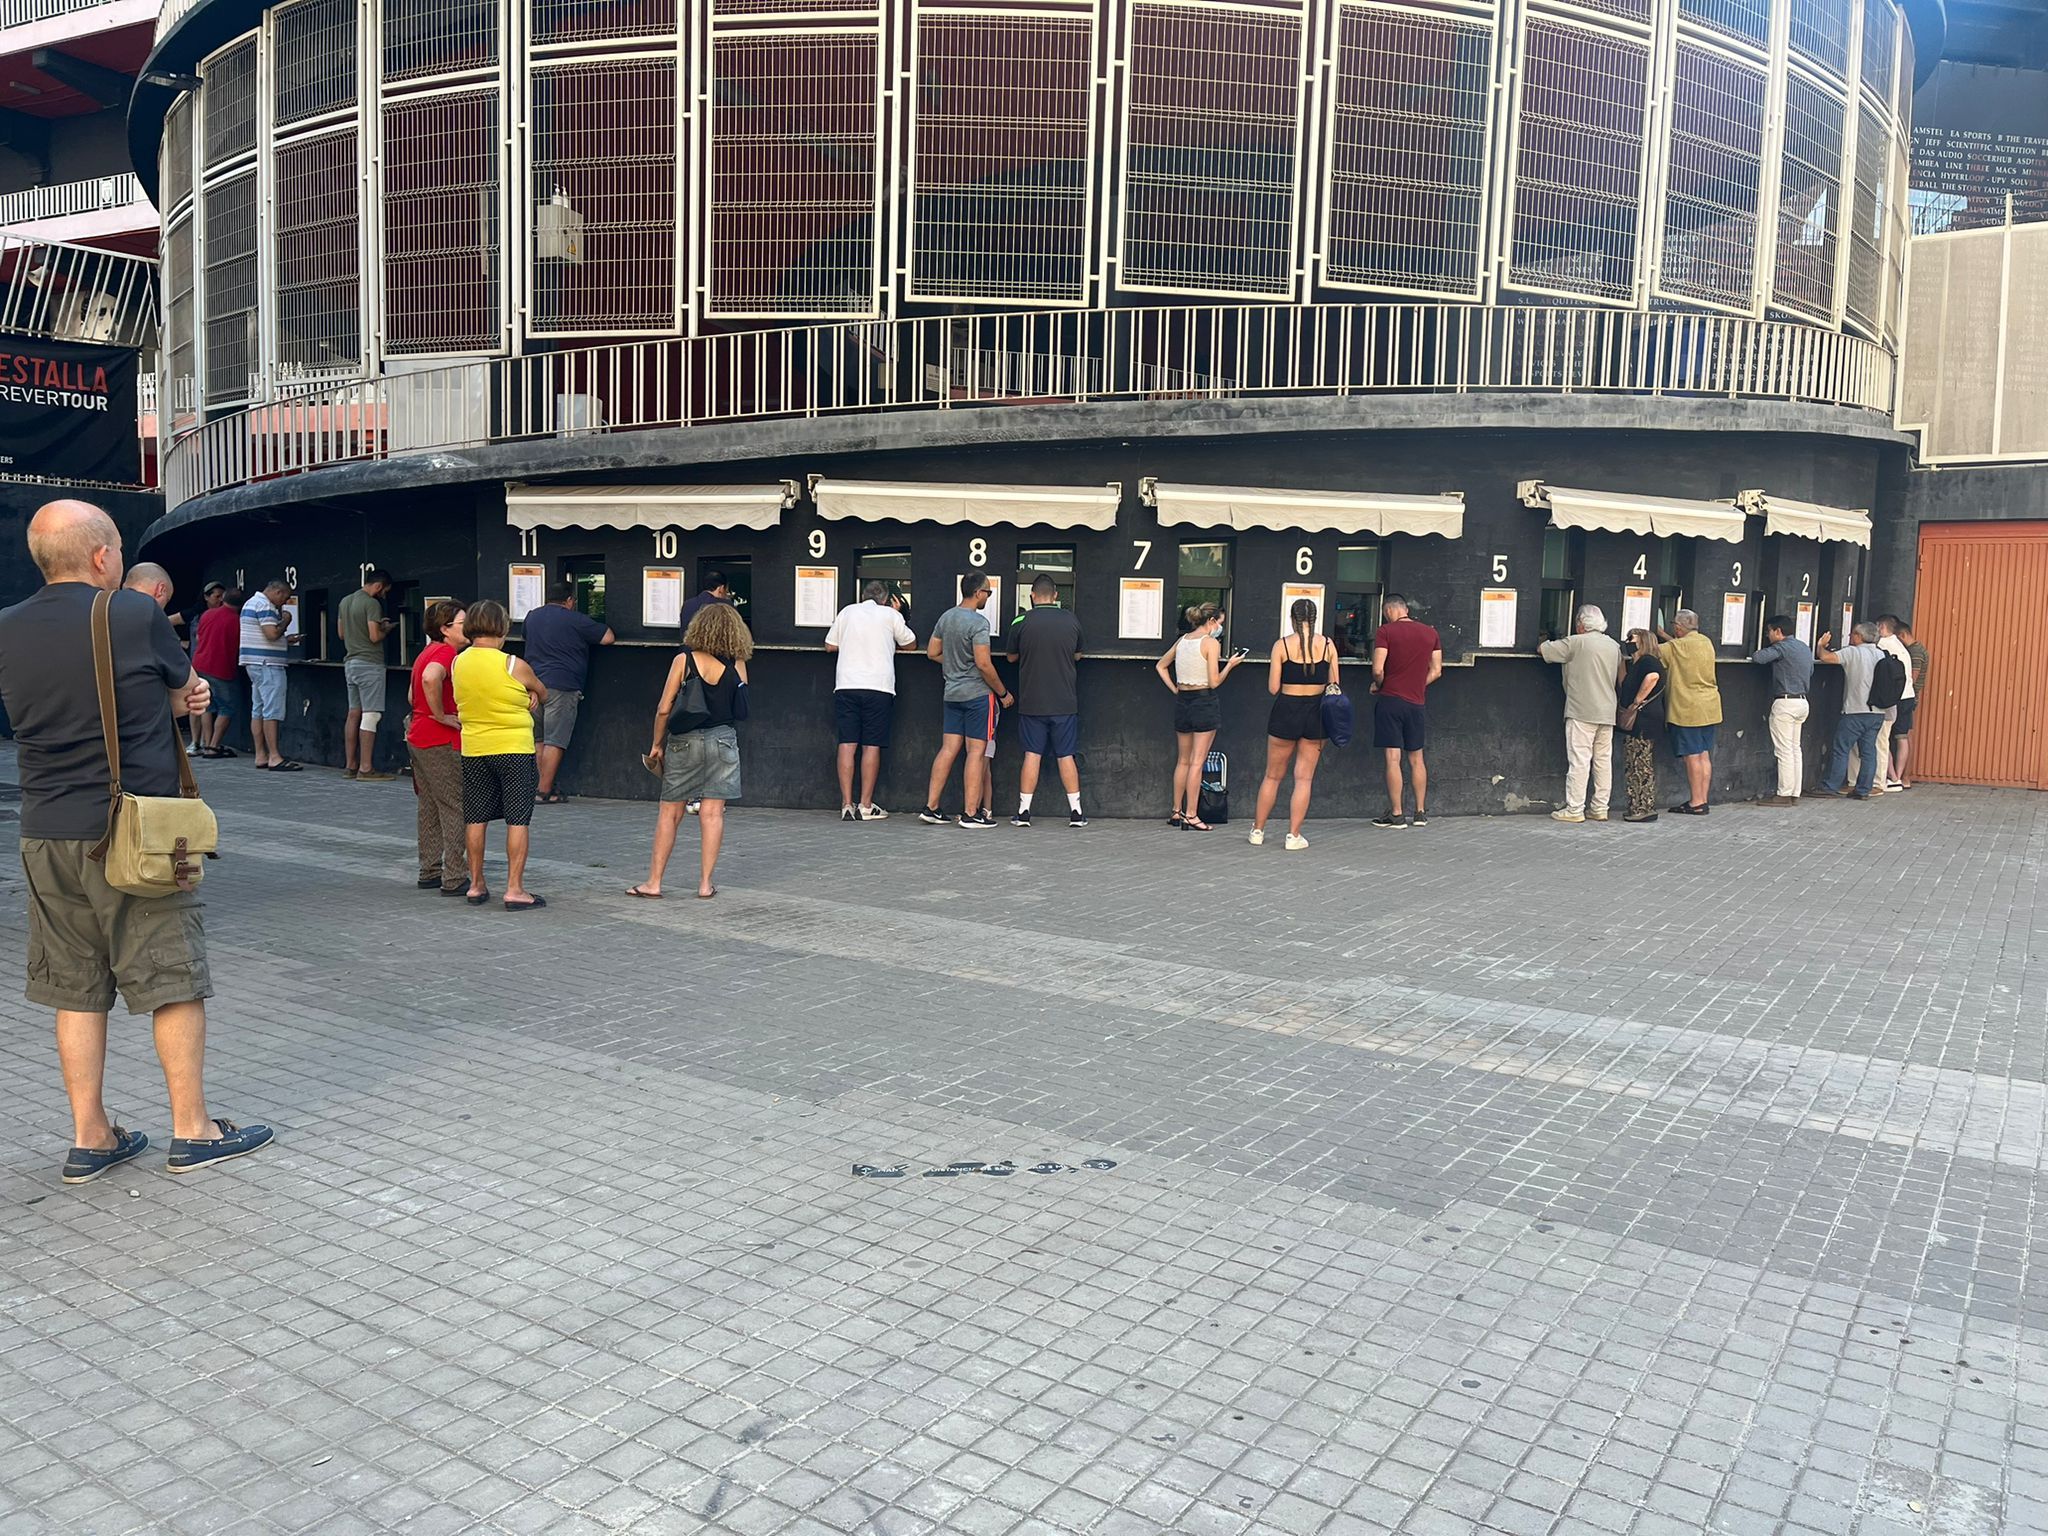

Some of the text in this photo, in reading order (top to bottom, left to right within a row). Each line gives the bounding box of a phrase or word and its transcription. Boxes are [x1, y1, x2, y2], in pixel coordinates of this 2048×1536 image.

[1913, 127, 1944, 136] AMSTEL
[1950, 130, 1960, 138] EA
[1963, 130, 1992, 141] SPORTS
[2006, 135, 2020, 143] THE
[1925, 138, 1941, 146] JEFF
[1995, 145, 2036, 155] NUTRITION
[1937, 150, 1963, 159] AUDIO
[1967, 153, 2012, 164] SOCCERHUB
[1945, 162, 1963, 170] LINE
[1965, 163, 1990, 173] THREE
[1995, 166, 2017, 175] MACS
[1941, 172, 1985, 182] HYPERLOOP
[1991, 176, 2006, 184] UPV
[1942, 182, 1955, 190] THE
[1957, 184, 1981, 193] STORY
[1995, 197, 2044, 208] TENOLOGY
[0, 353, 109, 393] ESTALLA
[0, 385, 108, 411] REVERTOUR
[519, 529, 537, 556] 11
[652, 531, 677, 559] 10
[808, 529, 826, 559] 9
[969, 538, 987, 567] 8
[1133, 540, 1152, 570] 7
[1295, 546, 1313, 575] 6
[1633, 553, 1647, 580] 4
[235, 568, 245, 591] 14
[284, 566, 297, 590] 13
[1492, 554, 1508, 582] 5
[1732, 562, 1742, 586] 3
[1802, 573, 1810, 597] 2
[1847, 575, 1852, 597] 1
